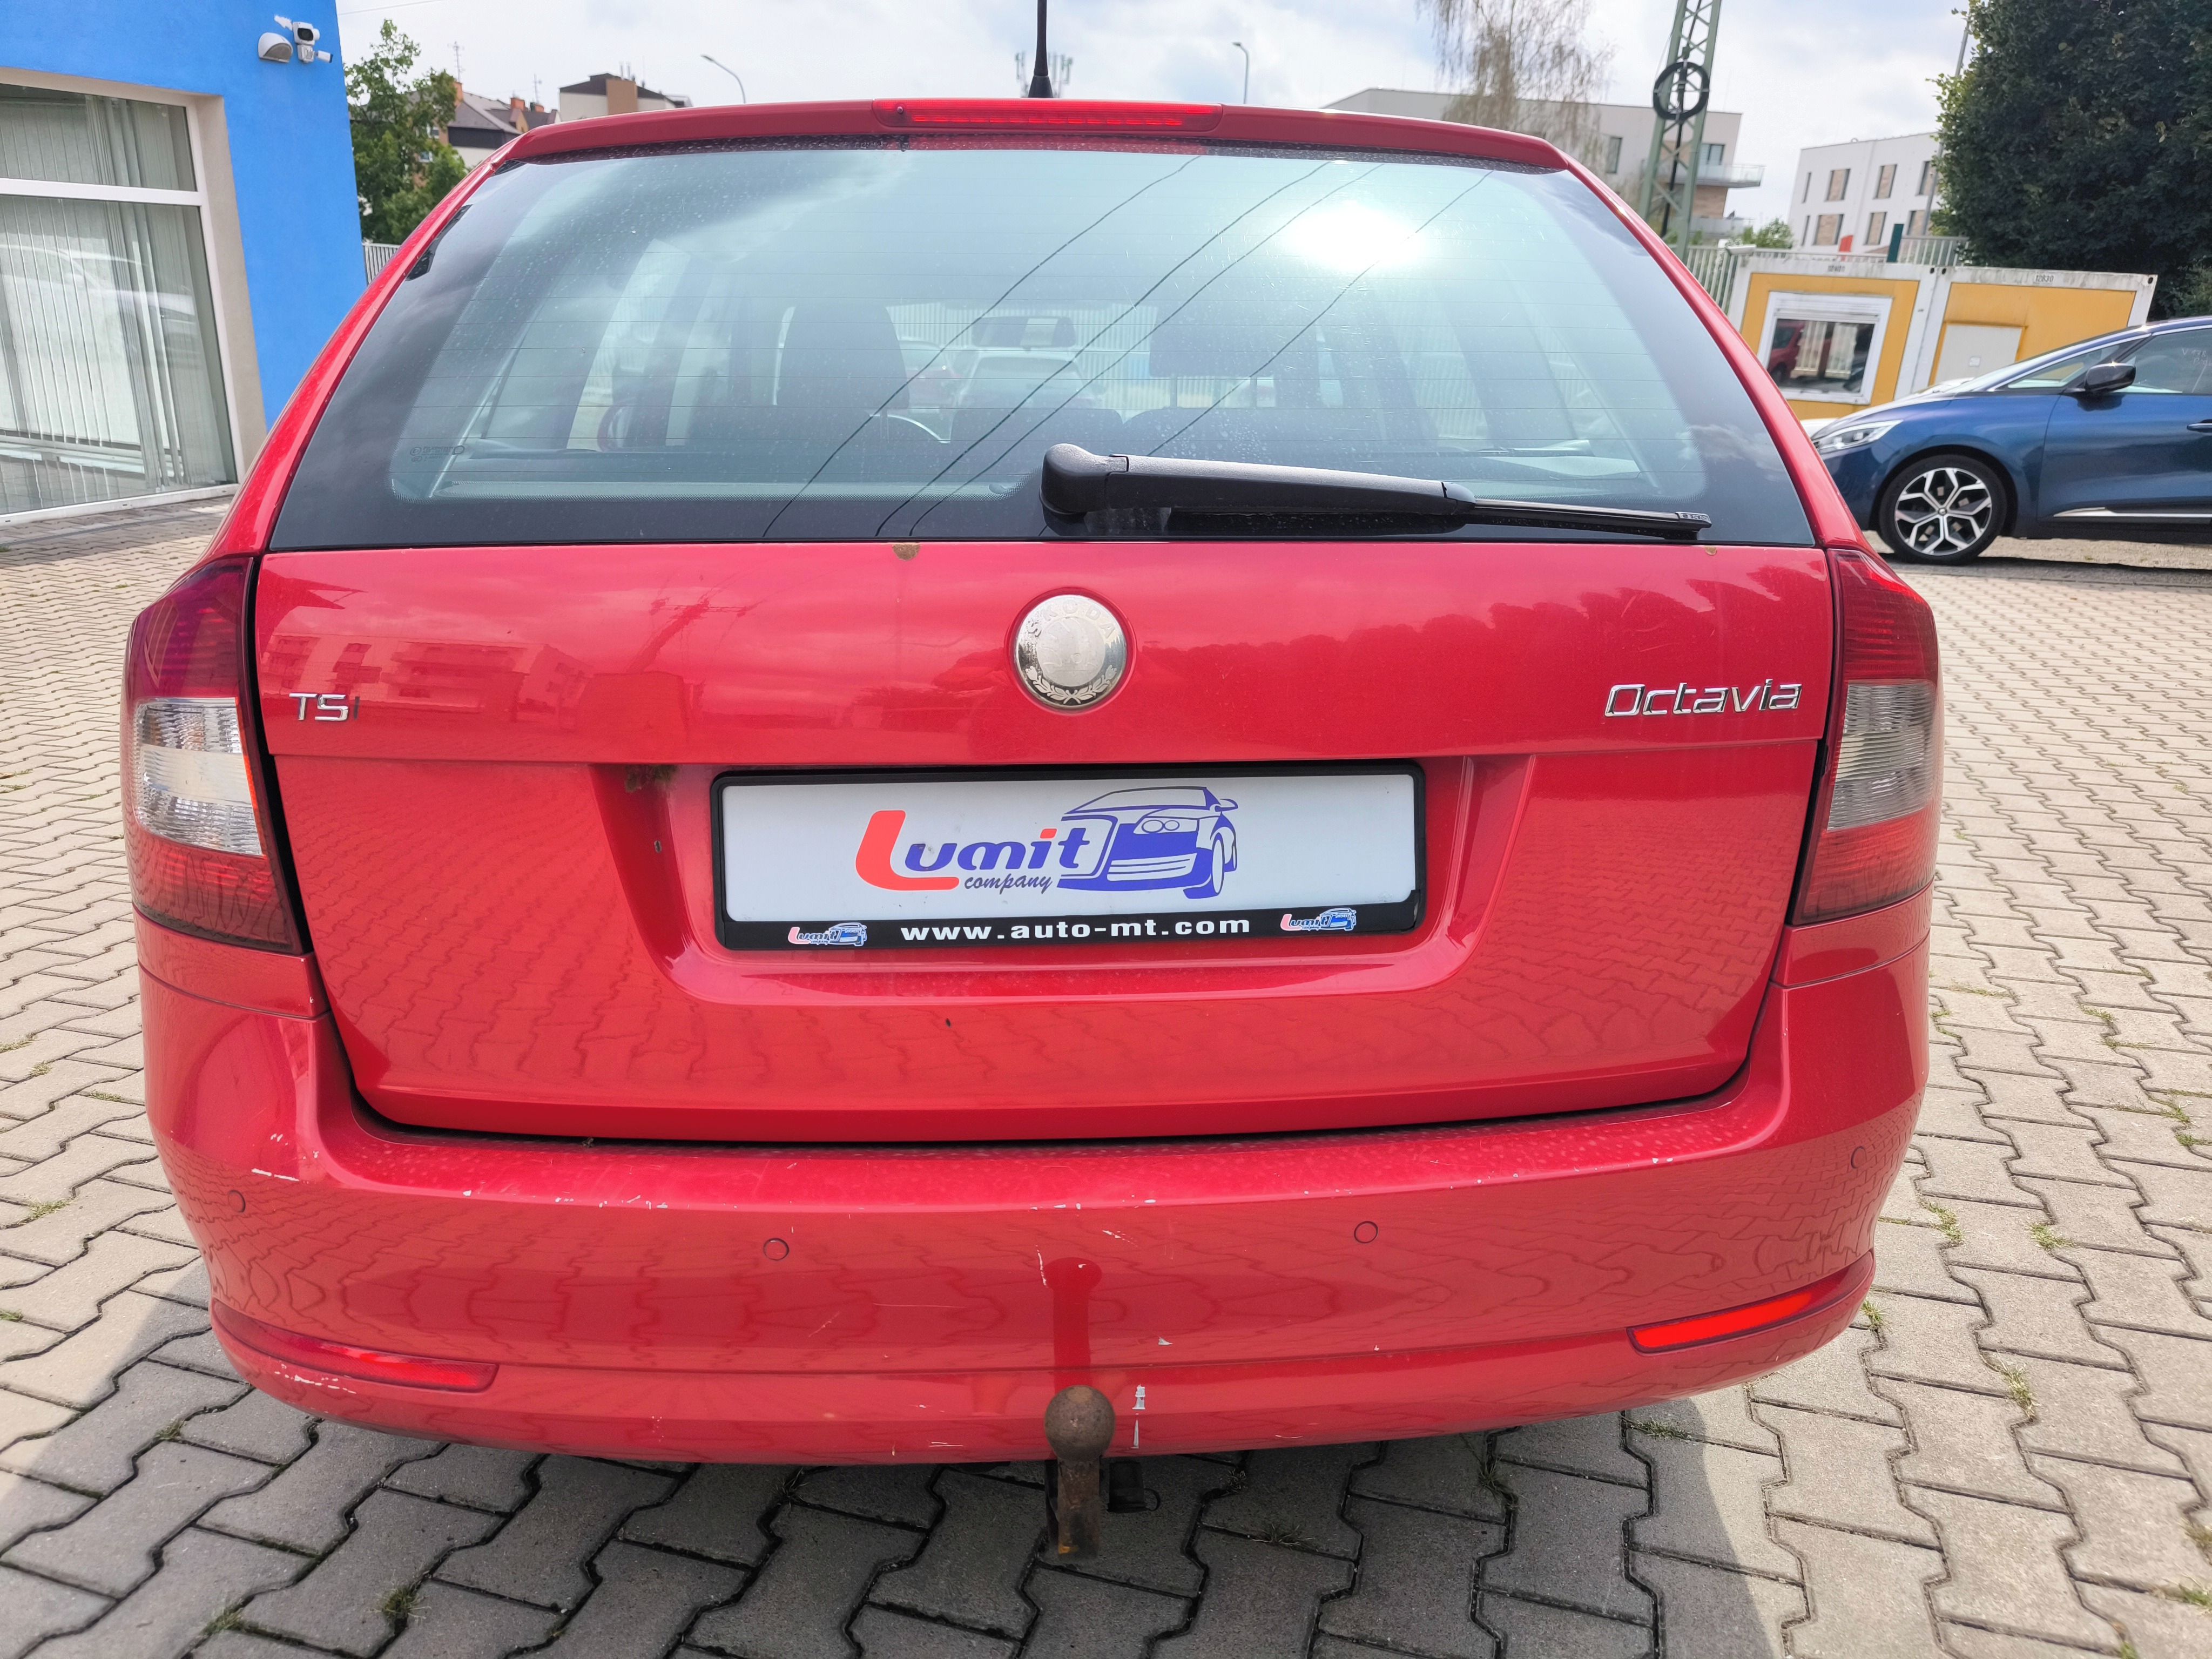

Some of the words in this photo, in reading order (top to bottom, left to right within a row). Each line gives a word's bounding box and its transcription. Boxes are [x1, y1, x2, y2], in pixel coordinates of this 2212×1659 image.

[289, 693, 361, 721] TSI
[1604, 679, 1803, 717] Octavia
[855, 810, 1090, 891] Lumit
[964, 873, 1053, 894] company
[900, 919, 1250, 940] www.auto-mt.com
[1280, 914, 1328, 931] Lumit
[788, 927, 837, 944] Lumit
